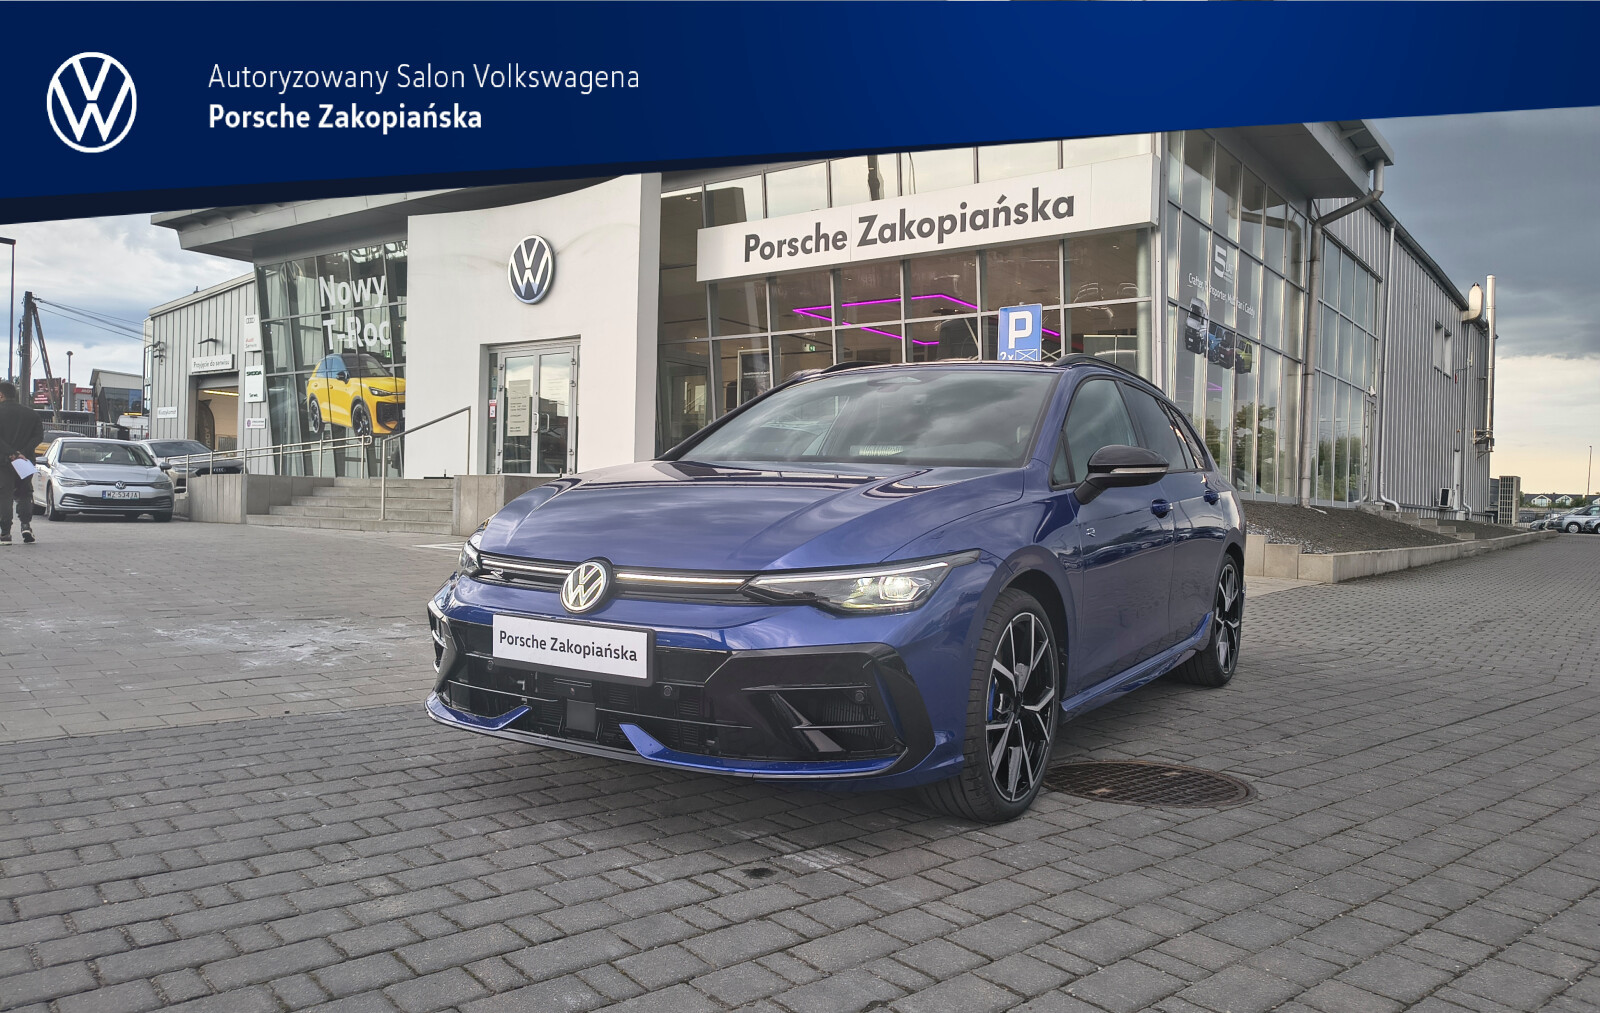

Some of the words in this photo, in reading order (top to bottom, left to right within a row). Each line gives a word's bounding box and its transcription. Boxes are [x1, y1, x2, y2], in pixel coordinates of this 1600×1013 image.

[744, 221, 848, 263] Porsche
[856, 186, 1075, 248] Zakopiańska
[319, 275, 387, 309] Nowy
[322, 316, 392, 351] T-Roc
[1008, 311, 1033, 350] P
[499, 630, 547, 650] Porsche
[550, 637, 638, 662] Zakopiańska
